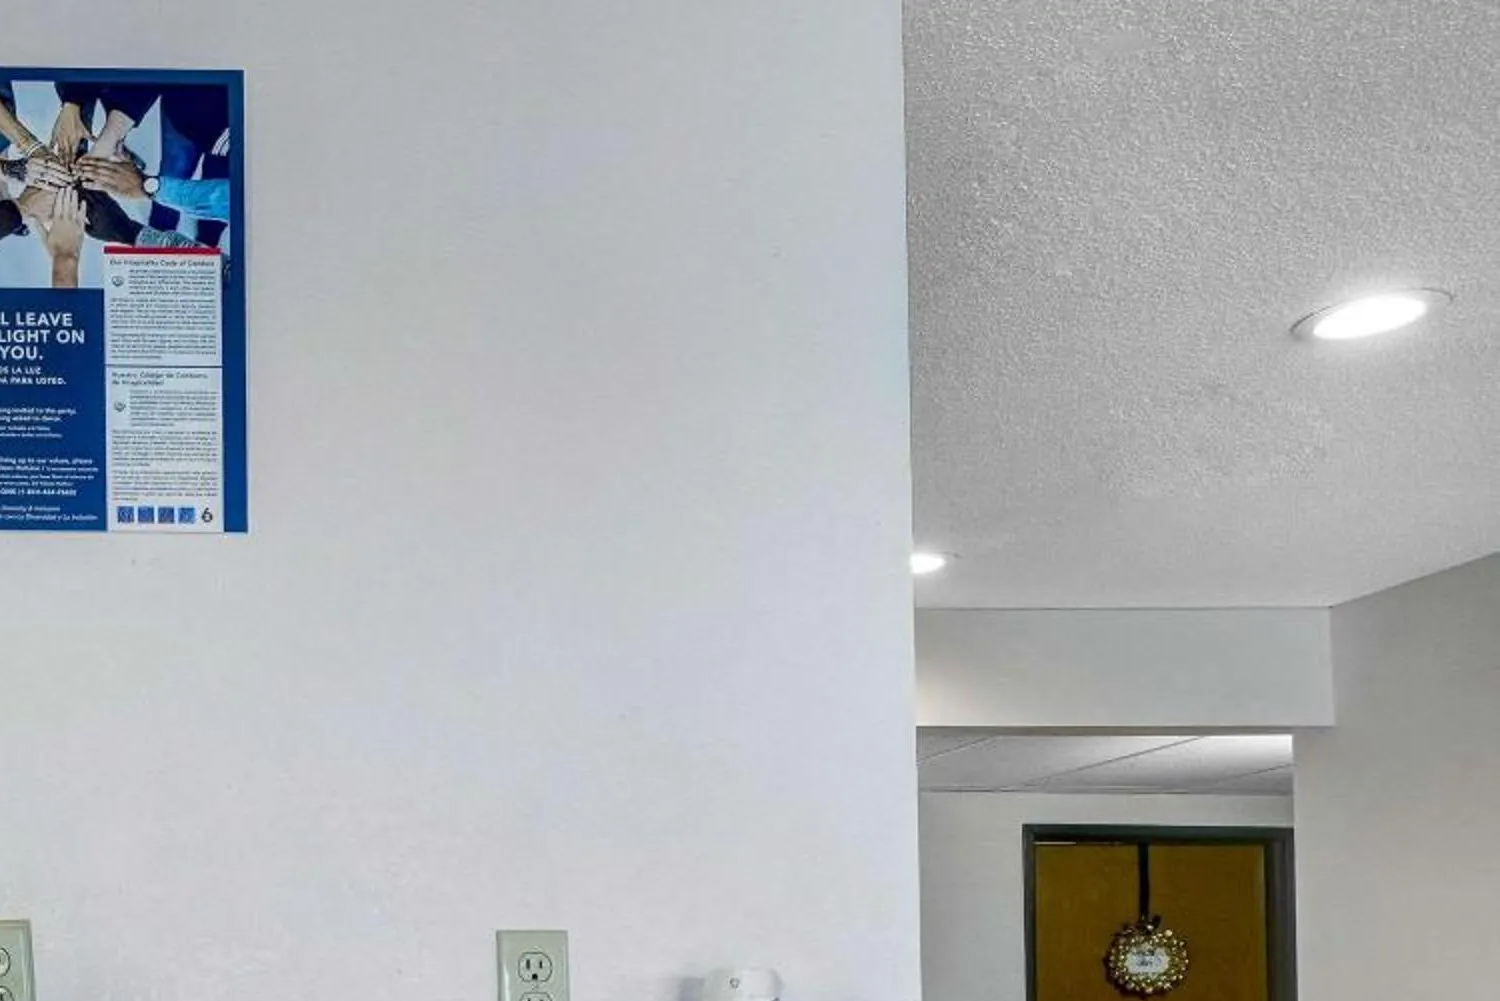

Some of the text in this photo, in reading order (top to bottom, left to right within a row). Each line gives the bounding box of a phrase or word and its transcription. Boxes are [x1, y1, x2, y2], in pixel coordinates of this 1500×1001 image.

[16, 312, 73, 327] LEAVE
[56, 330, 85, 344] ON
[201, 507, 215, 523] 6
